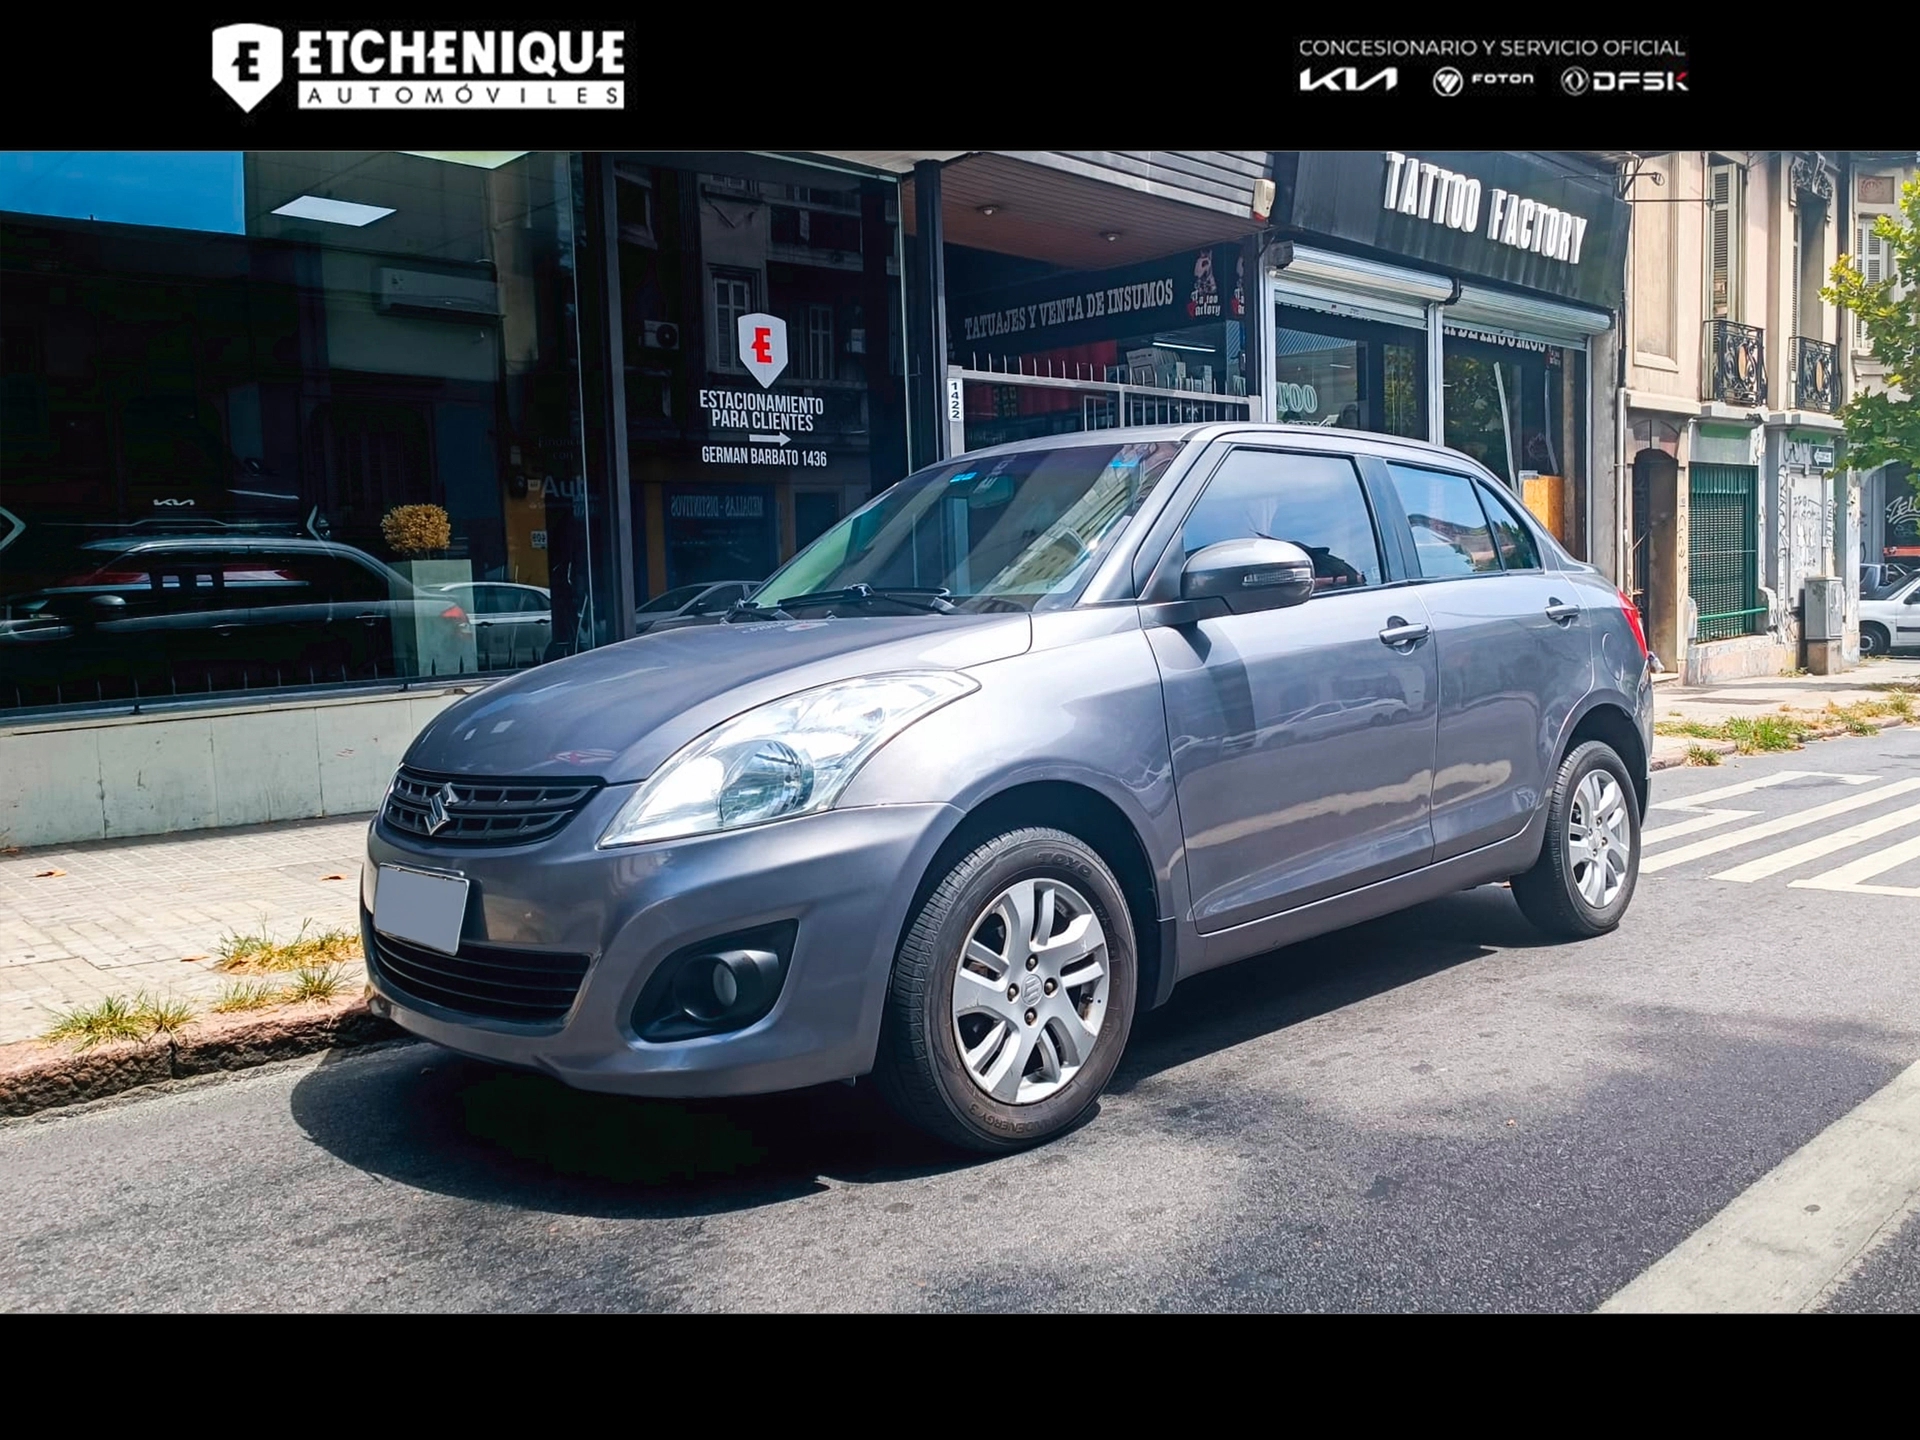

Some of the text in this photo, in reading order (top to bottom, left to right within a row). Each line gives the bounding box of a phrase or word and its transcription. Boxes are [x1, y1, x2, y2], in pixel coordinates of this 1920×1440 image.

[1384, 151, 1588, 264] TATTOO FACTORY
[965, 278, 1174, 341] TATUAJES Y VENTA DE INSUMOS
[699, 389, 824, 415] ESTACIONAMIENTO
[949, 379, 962, 420] 1422
[712, 409, 814, 432] PARA CLIENTES
[702, 446, 827, 467] GERMAN BARBATO 1436
